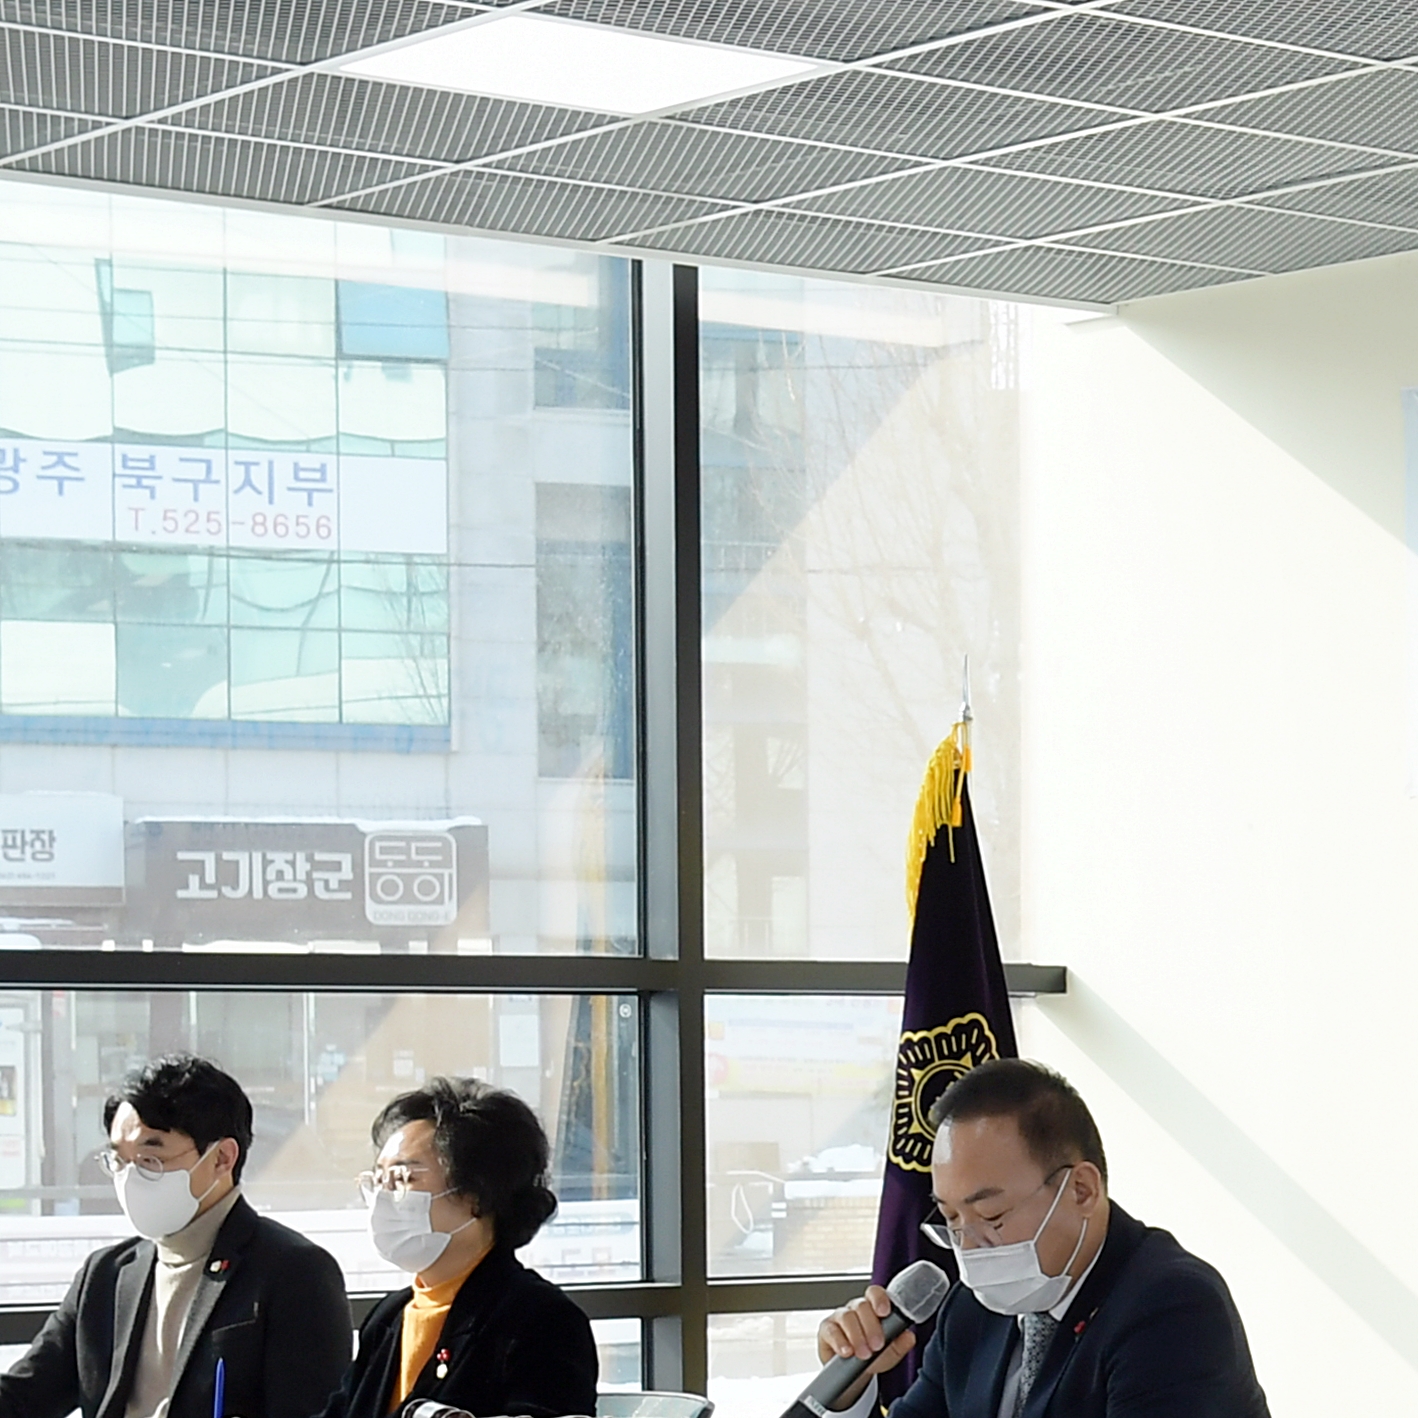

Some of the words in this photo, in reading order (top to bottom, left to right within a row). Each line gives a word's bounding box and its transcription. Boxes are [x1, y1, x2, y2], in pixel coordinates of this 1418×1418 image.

[113, 453, 335, 508] 북구지부
[127, 506, 333, 540] T.525-8656
[175, 851, 355, 900] 고기장군
